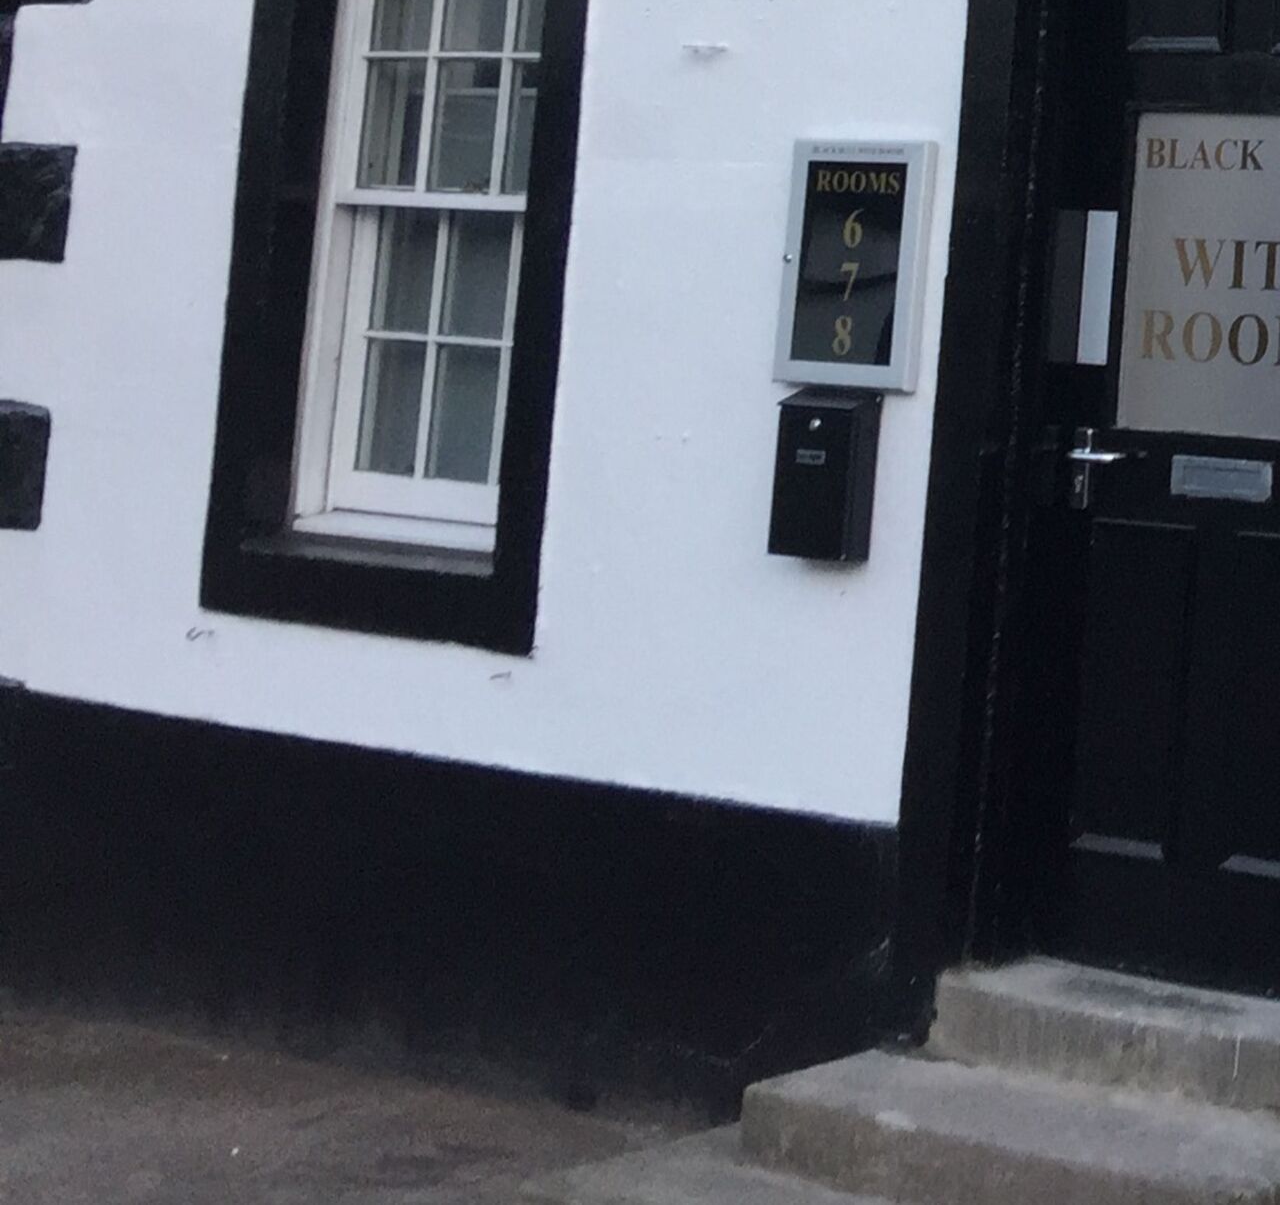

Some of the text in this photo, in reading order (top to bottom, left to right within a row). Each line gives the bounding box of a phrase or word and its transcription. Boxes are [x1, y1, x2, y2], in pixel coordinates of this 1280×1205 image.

[1147, 137, 1264, 171] BLACK
[816, 169, 901, 195] ROOMS
[841, 208, 863, 249] 6
[839, 261, 860, 302] 7
[831, 315, 853, 356] 8
